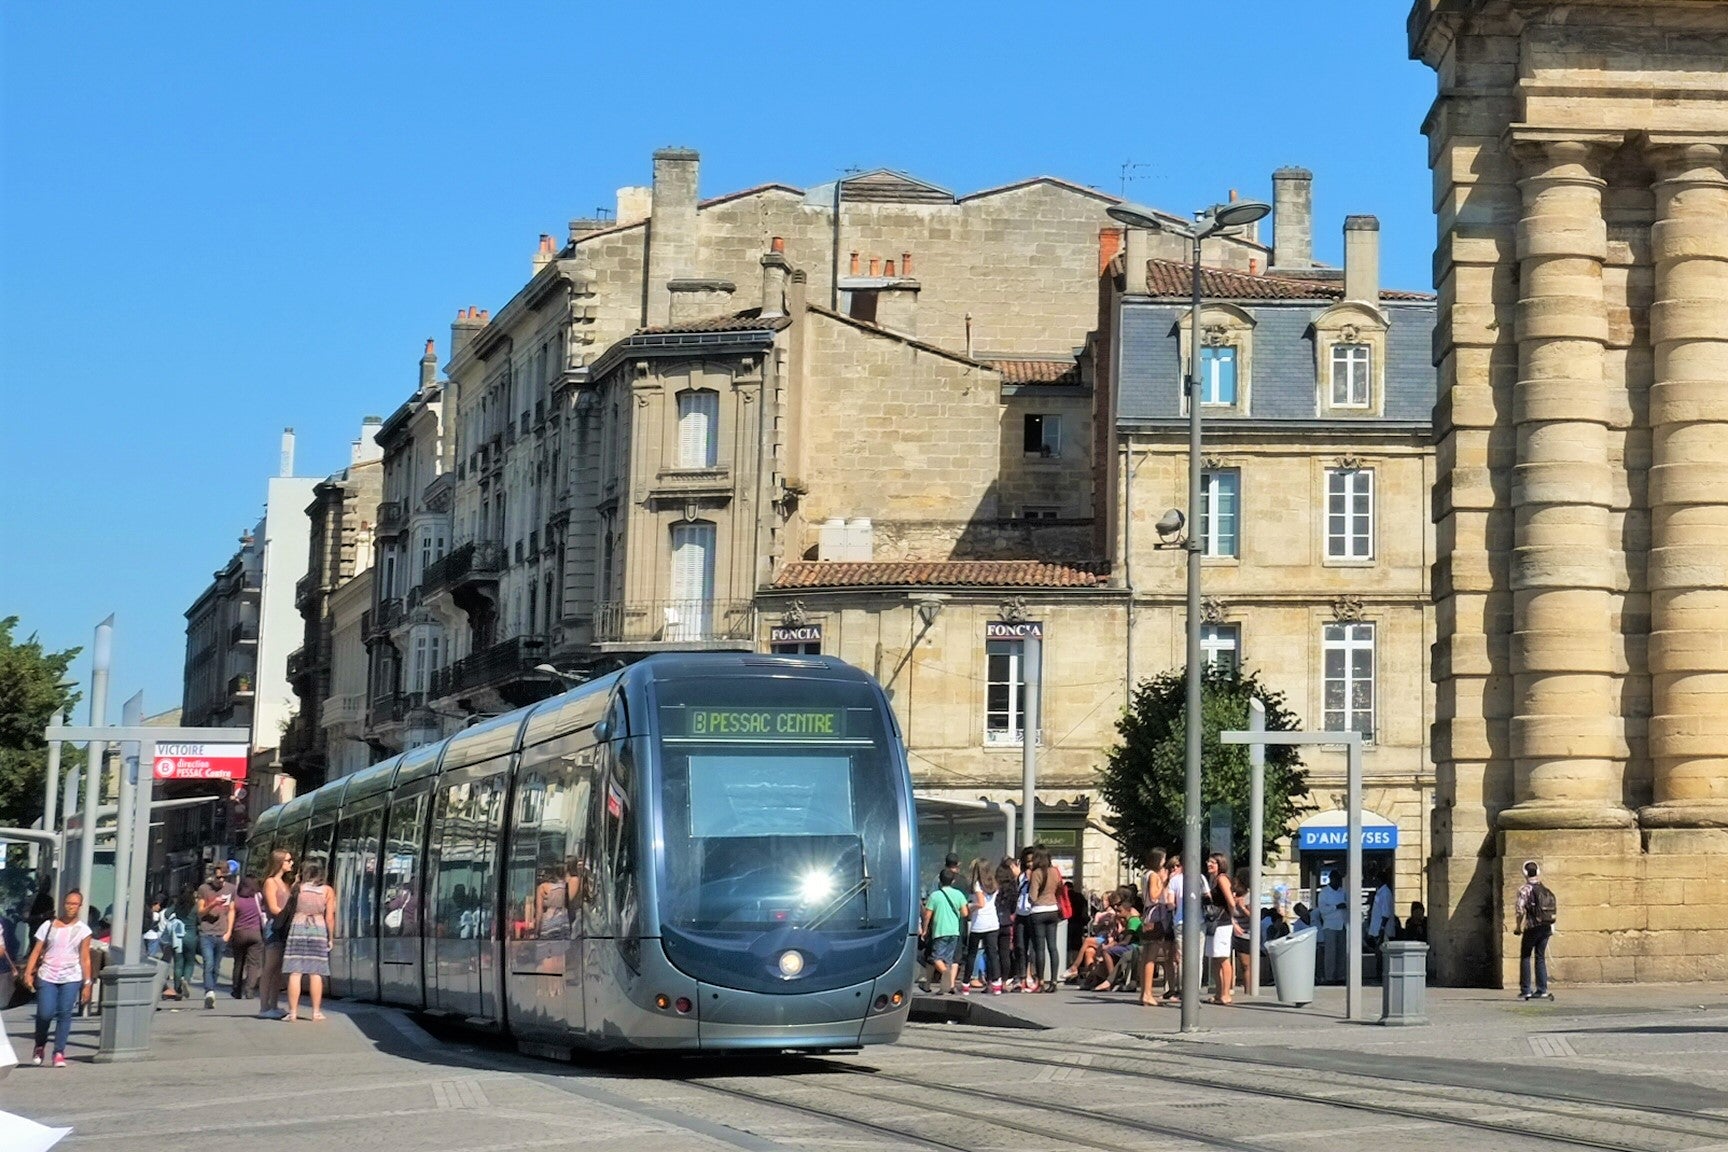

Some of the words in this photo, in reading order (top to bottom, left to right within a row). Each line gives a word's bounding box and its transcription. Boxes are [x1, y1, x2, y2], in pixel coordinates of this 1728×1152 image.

[771, 628, 821, 641] FONCIA
[693, 711, 706, 733] B
[709, 713, 771, 733] PESSAC
[776, 714, 834, 733] CENTRE
[158, 744, 204, 756] VICTOIRE
[176, 759, 210, 768] direction
[176, 769, 203, 778] PESSAC
[1306, 832, 1390, 844] D'ANAYSES
